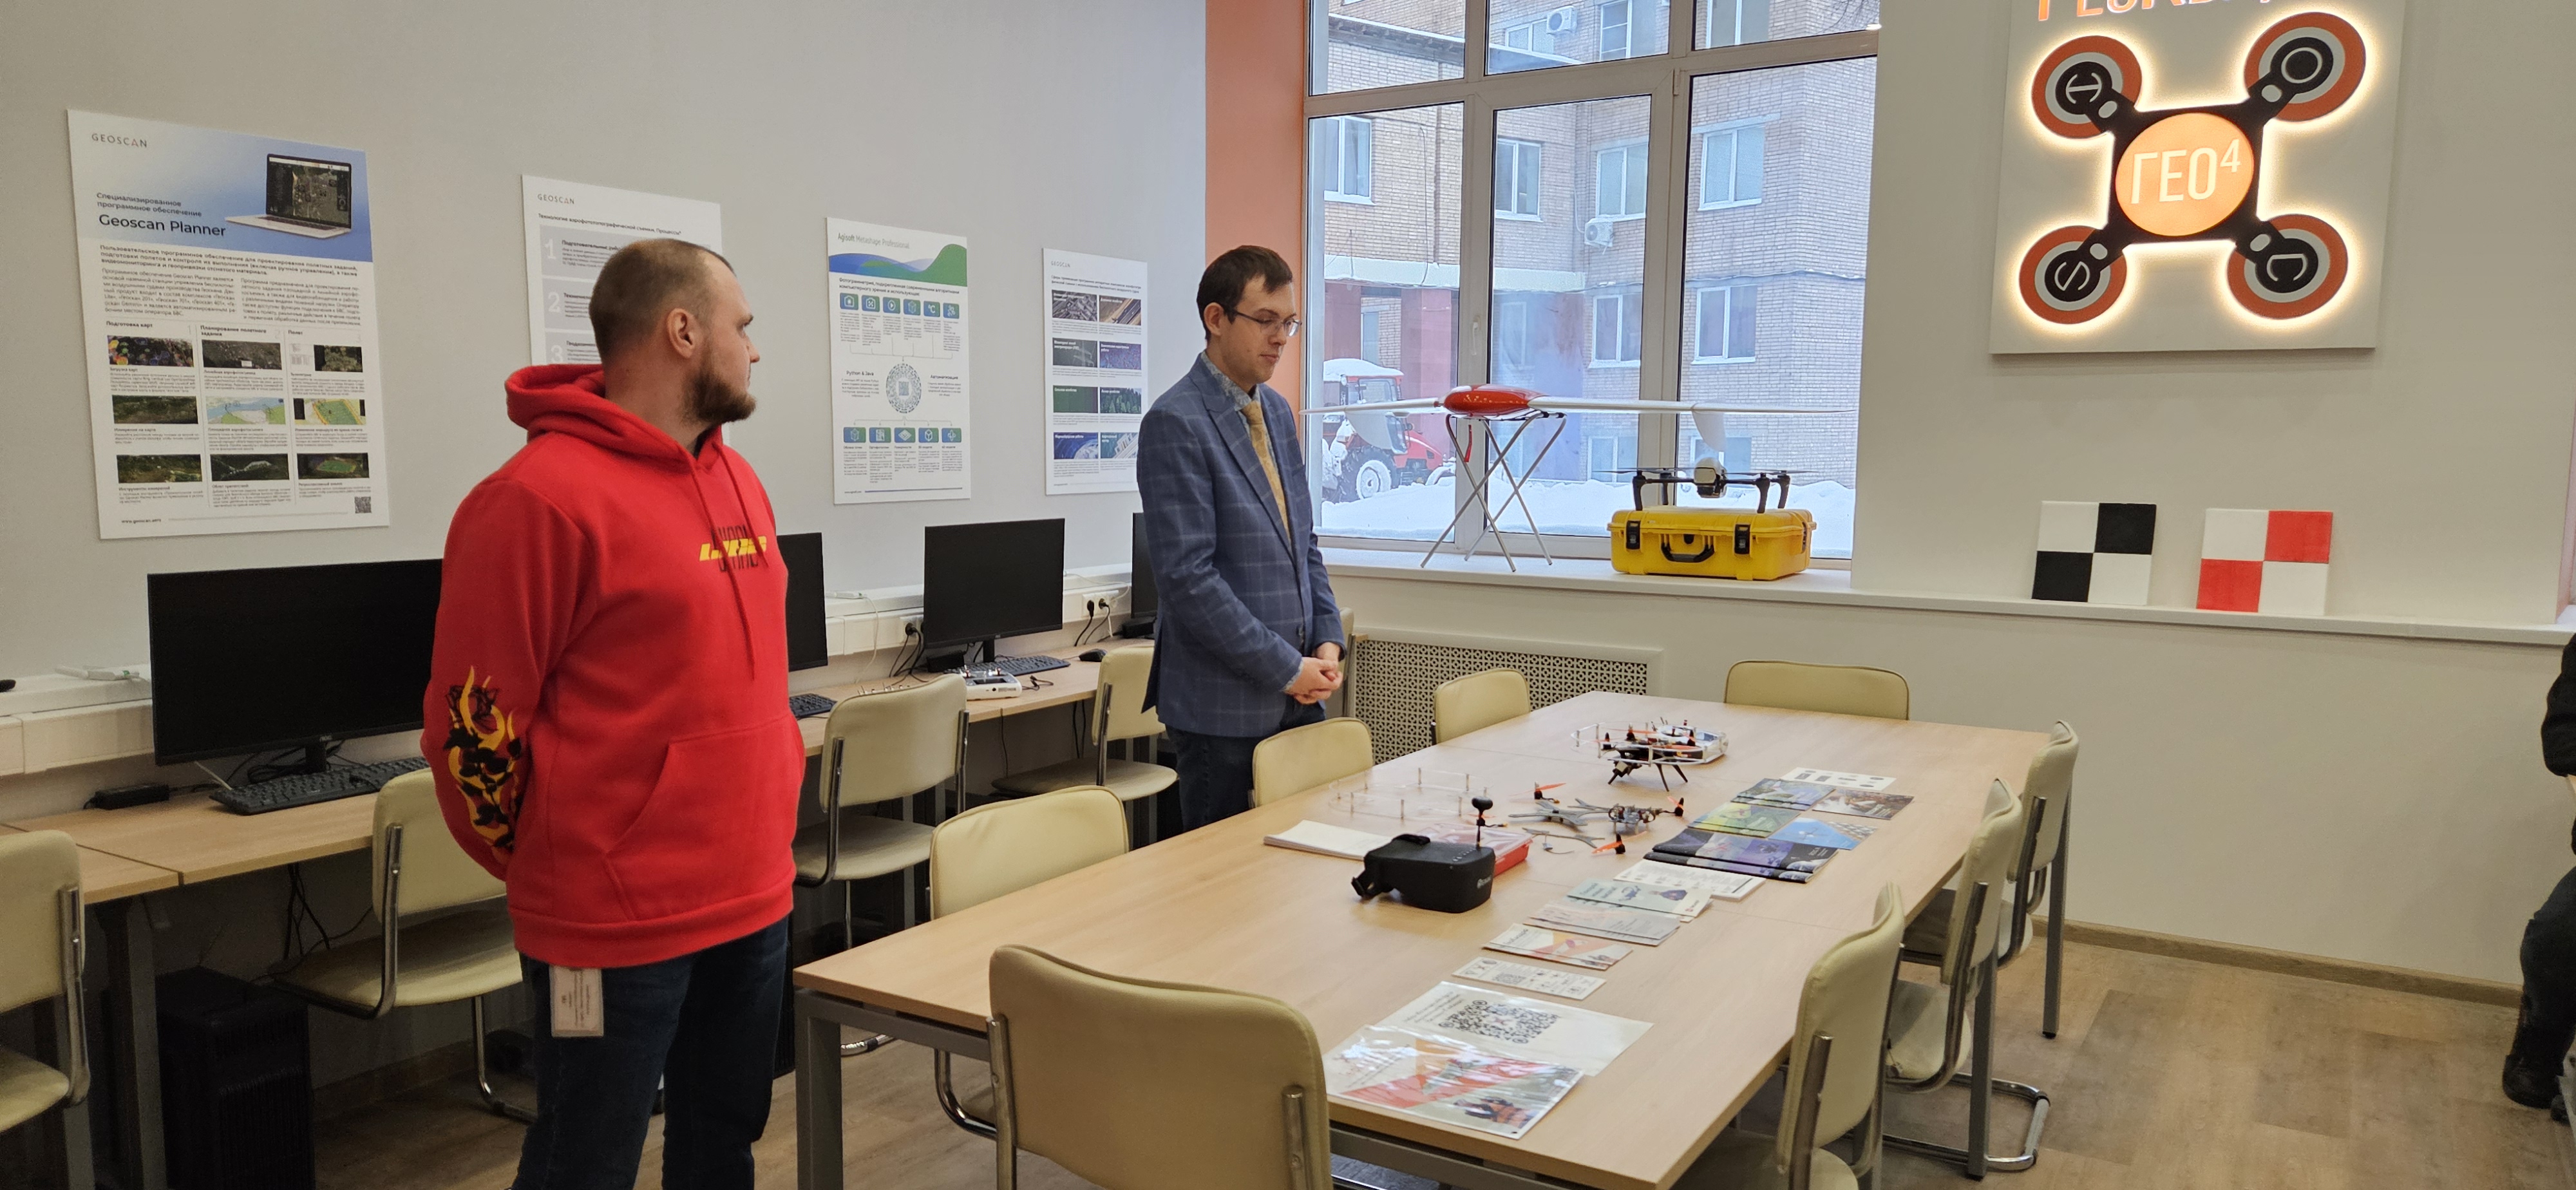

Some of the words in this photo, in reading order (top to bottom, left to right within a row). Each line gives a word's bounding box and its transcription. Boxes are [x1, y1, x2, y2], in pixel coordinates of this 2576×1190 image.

[91, 133, 147, 148] GEOSCAN
[96, 192, 182, 208] Специализированное
[537, 193, 574, 205] GEOSCAN
[97, 202, 151, 212] программное
[152, 206, 202, 216] обеспечение
[98, 214, 165, 231] Geoscan
[169, 220, 226, 236] Planner
[838, 232, 855, 243] Agisoft
[100, 244, 159, 254] Пользовательское
[160, 250, 203, 259] программное
[100, 252, 138, 260] подготовки
[544, 238, 556, 259] 1
[101, 258, 160, 268] видеомониторинга
[167, 263, 205, 271] геопривязки
[547, 292, 560, 312] 2
